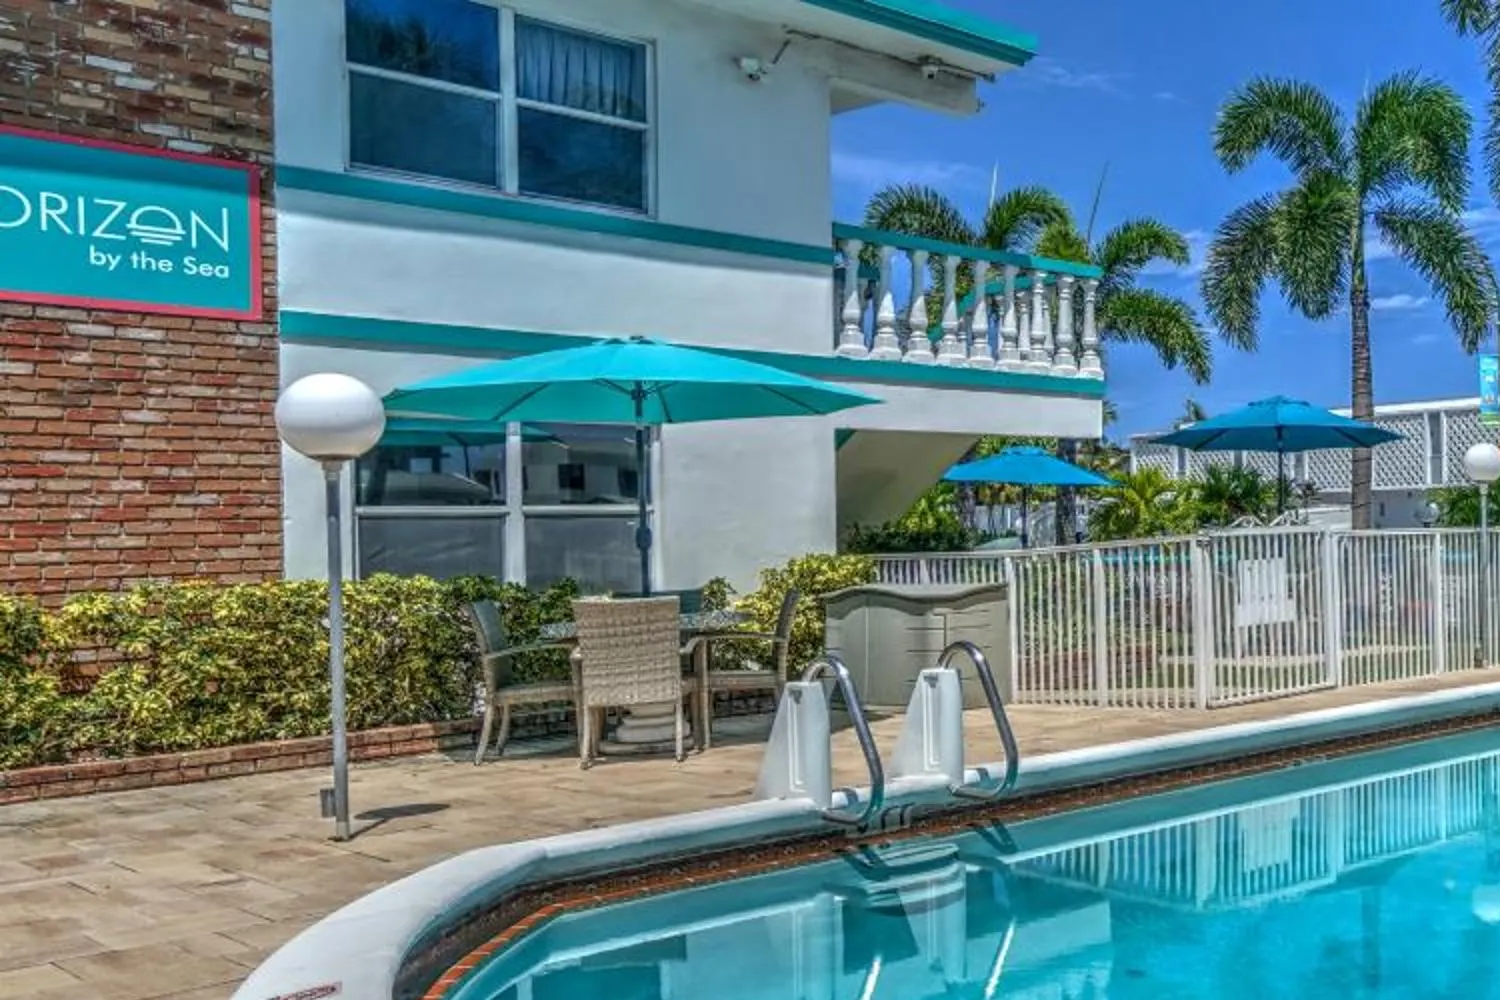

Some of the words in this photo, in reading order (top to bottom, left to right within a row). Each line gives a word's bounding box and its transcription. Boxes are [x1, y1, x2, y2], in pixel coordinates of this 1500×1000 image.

[89, 245, 121, 271] by
[130, 249, 173, 273] the
[183, 256, 230, 279] Sea
